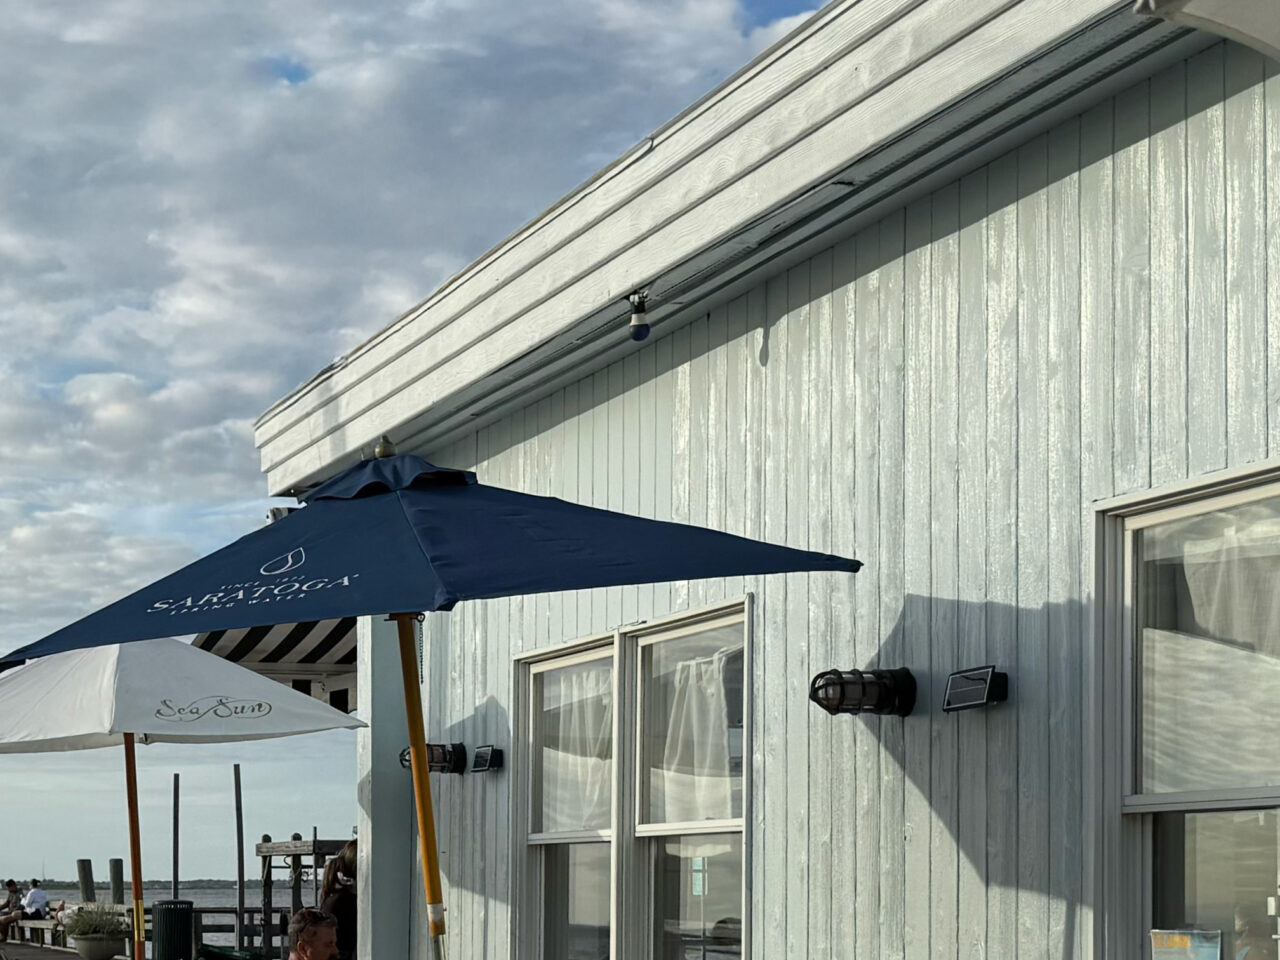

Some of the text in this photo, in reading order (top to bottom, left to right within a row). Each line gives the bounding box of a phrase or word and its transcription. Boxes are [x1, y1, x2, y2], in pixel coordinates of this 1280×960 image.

[147, 575, 349, 613] SARATOGA
[169, 593, 306, 615] SPRING WATER
[155, 699, 270, 720] Sea Sun
